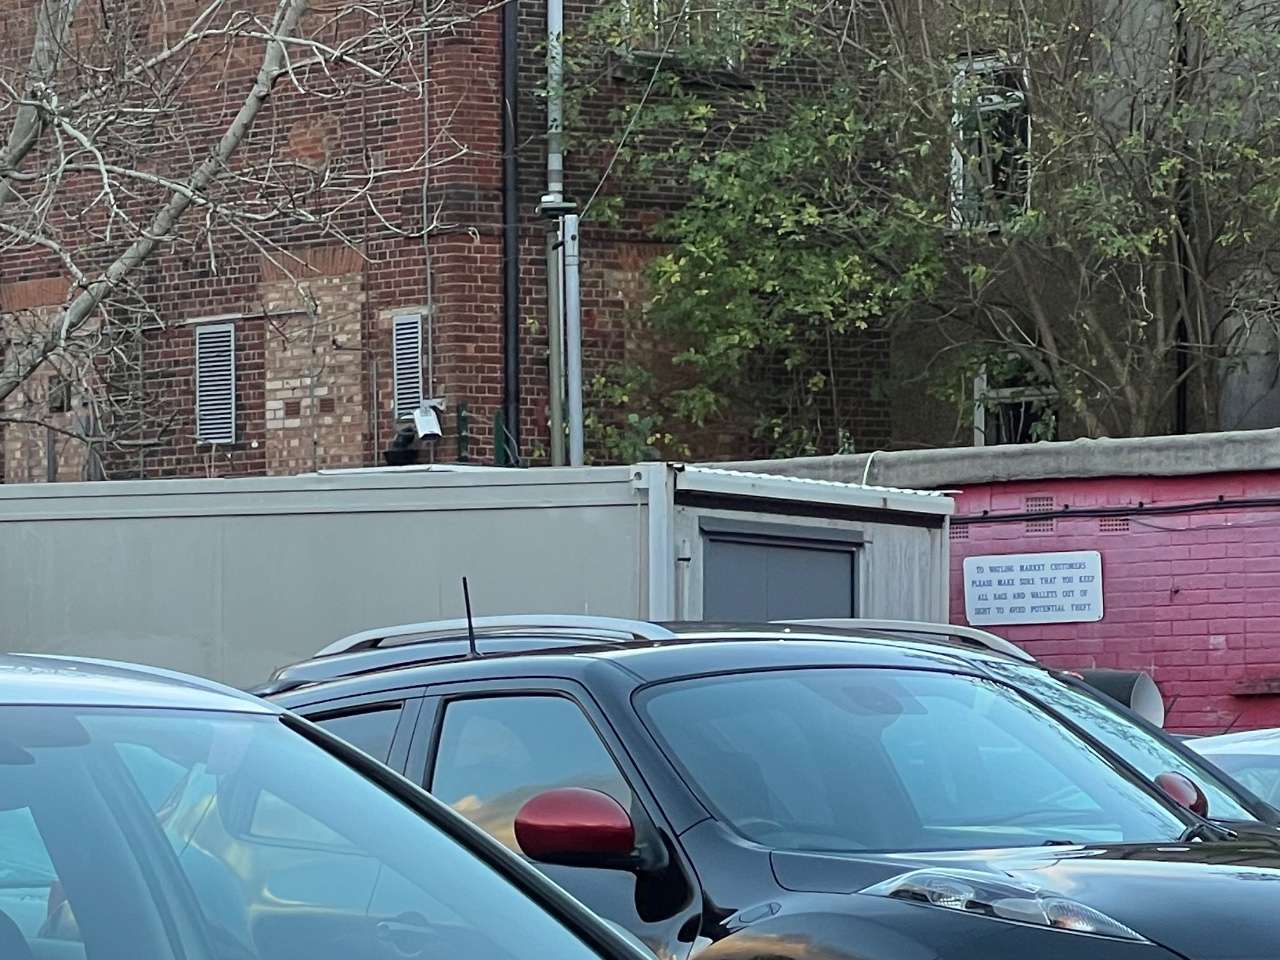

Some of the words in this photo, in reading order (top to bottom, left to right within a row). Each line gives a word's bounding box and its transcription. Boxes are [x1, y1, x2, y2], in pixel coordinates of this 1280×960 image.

[976, 566, 984, 574] TO
[972, 580, 992, 588] PLEASE
[1040, 576, 1056, 584] THAT
[978, 593, 988, 601] ALL
